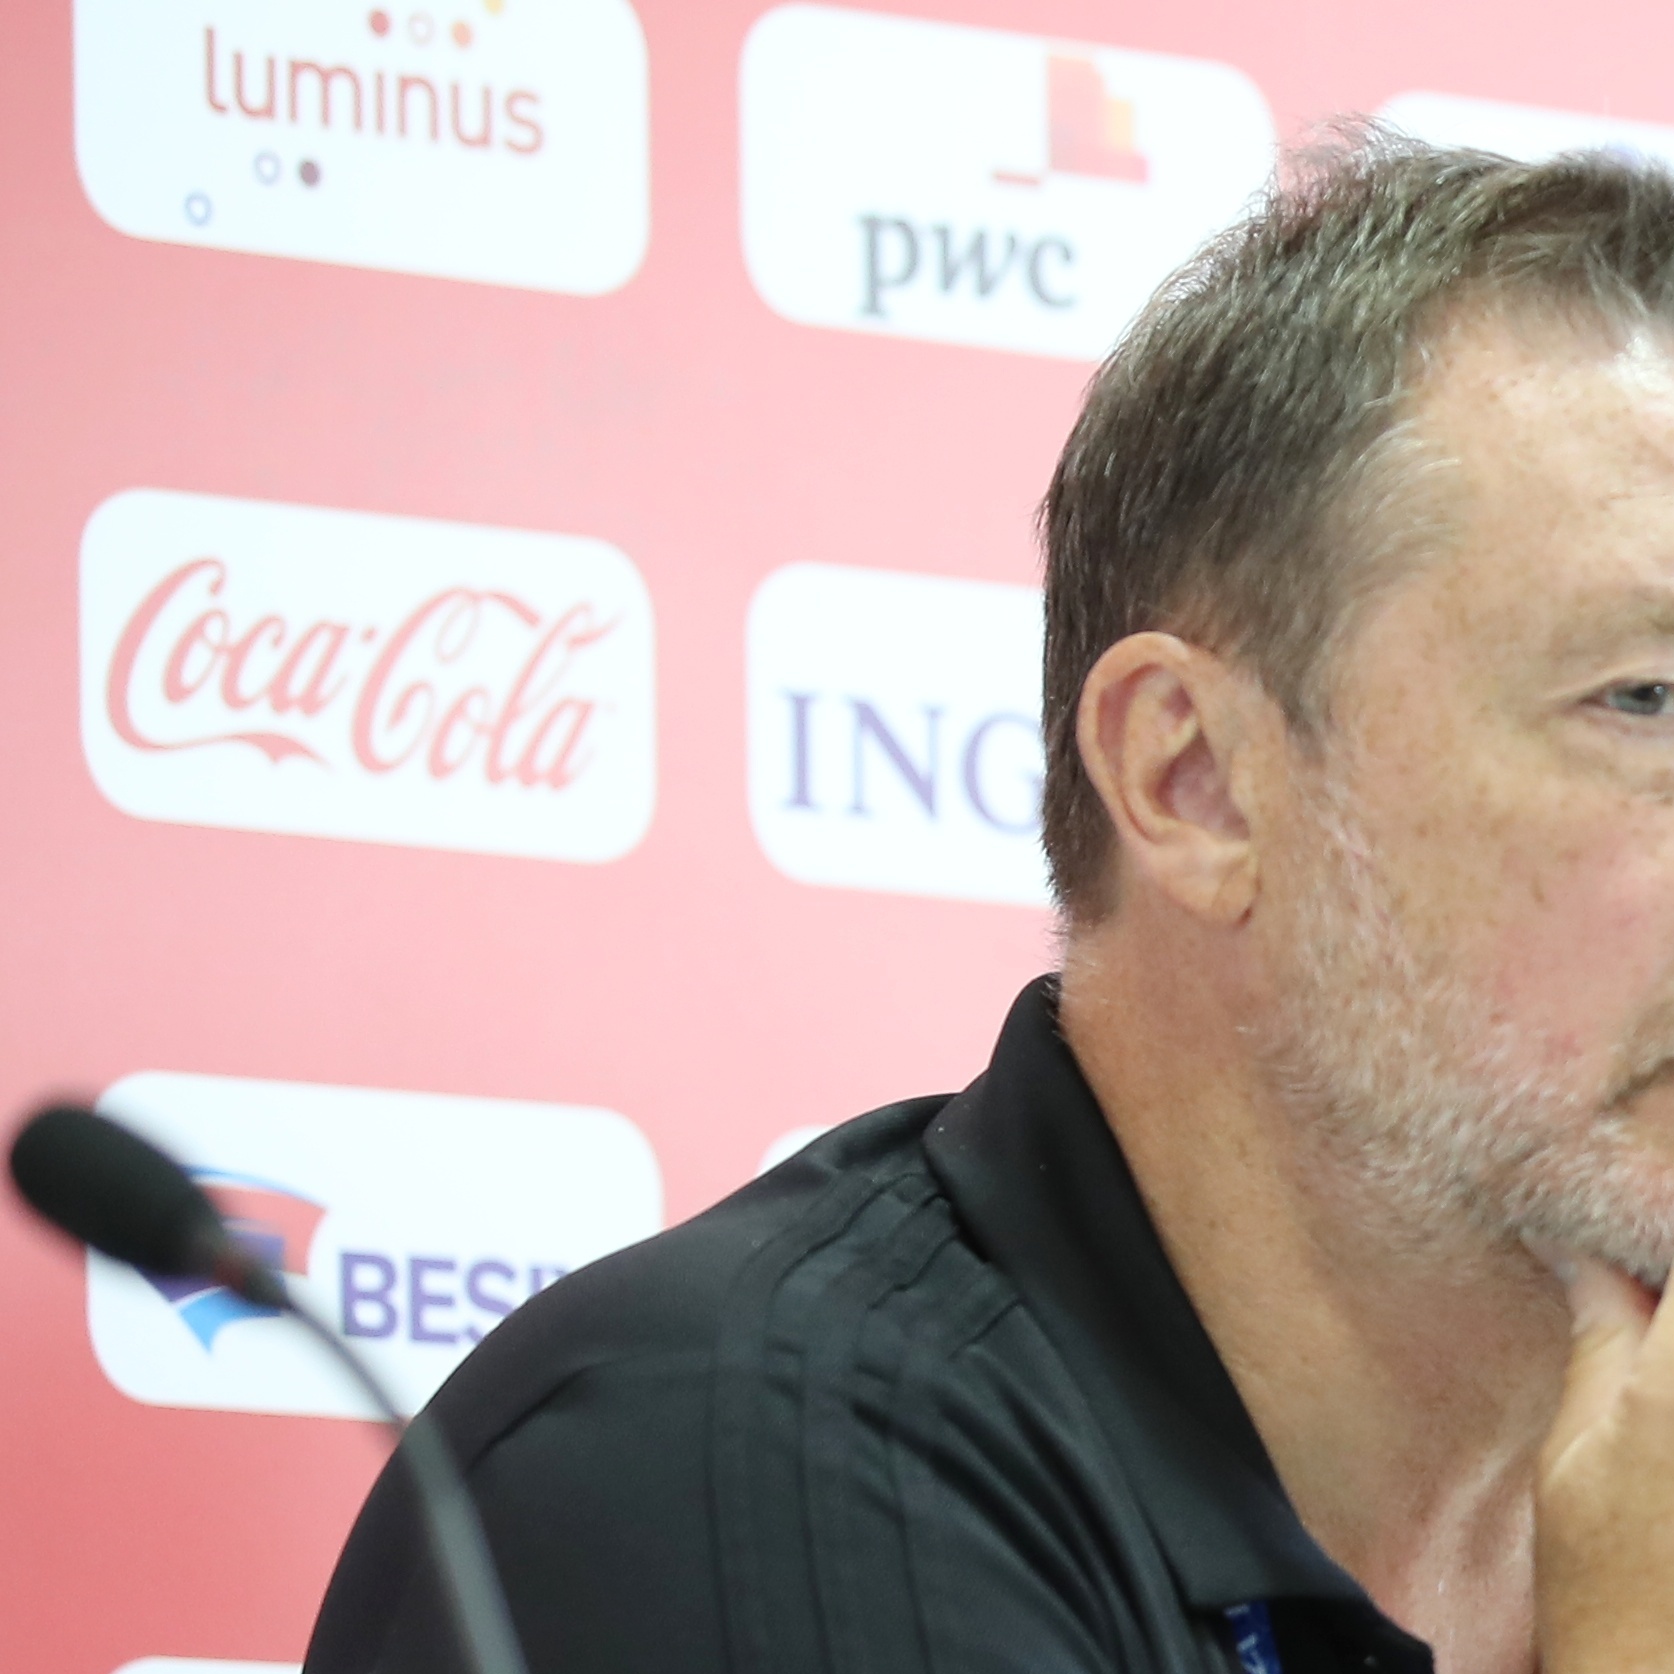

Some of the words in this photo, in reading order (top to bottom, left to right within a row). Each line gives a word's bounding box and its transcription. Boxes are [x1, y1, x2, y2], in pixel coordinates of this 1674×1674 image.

[205, 27, 546, 156] luminus
[858, 213, 1077, 317] pwc
[780, 689, 1044, 833] ING
[340, 1252, 573, 1344] BES
